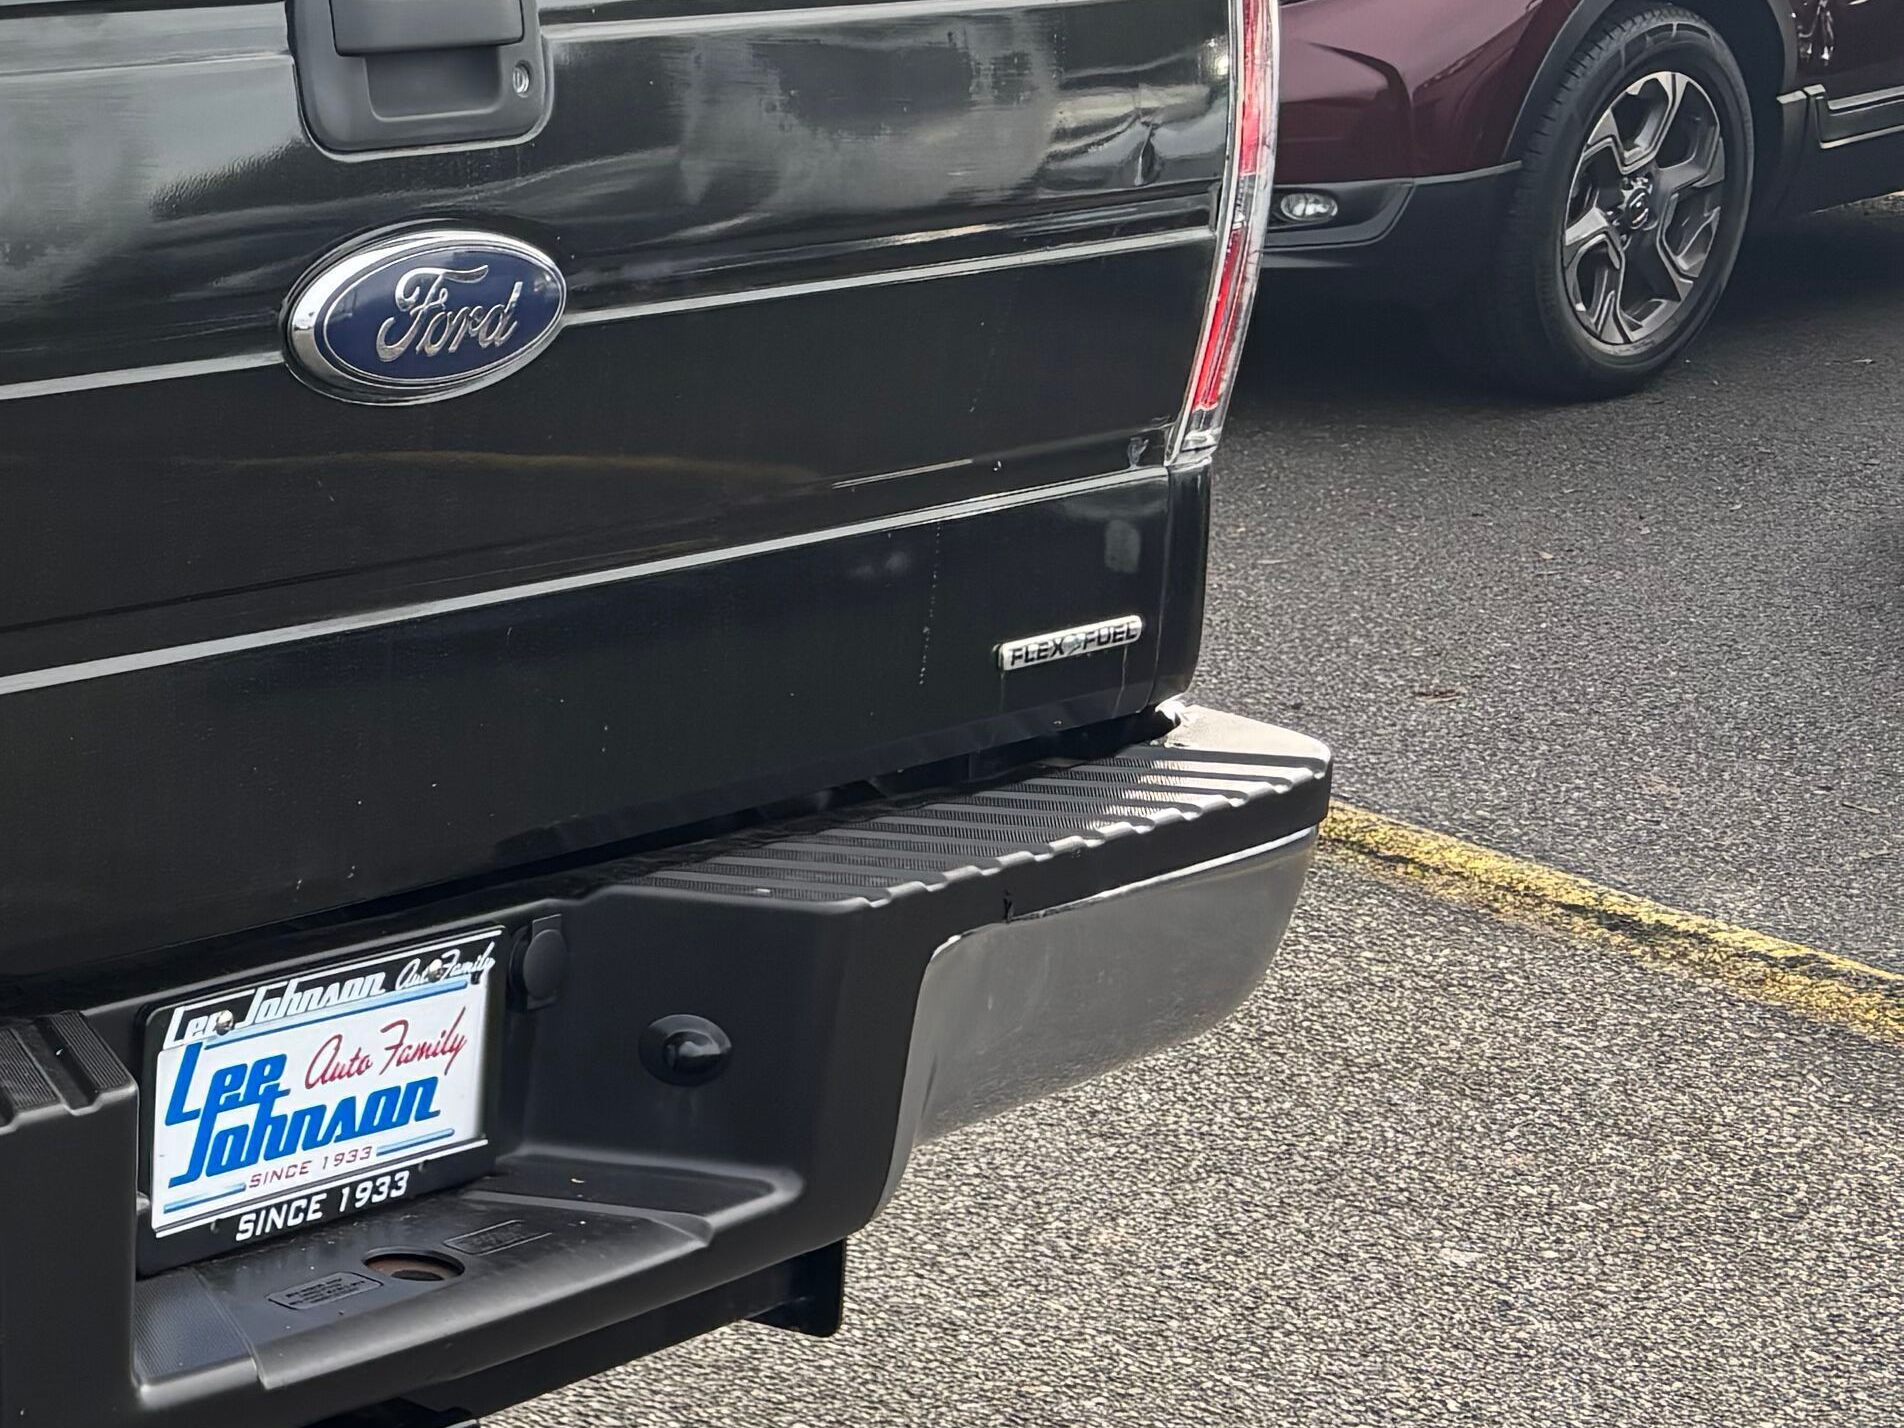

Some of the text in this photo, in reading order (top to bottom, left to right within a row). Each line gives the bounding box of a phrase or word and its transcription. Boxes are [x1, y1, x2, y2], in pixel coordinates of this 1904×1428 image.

[376, 264, 523, 362] Ford
[1010, 622, 1138, 666] FLEX FUEL
[234, 971, 386, 1029] Johnson
[395, 958, 438, 990] Aut
[439, 941, 496, 984] Family
[165, 1007, 468, 1126] Lee Auto Family
[169, 1076, 441, 1189] Johnson
[248, 1146, 373, 1189] SINCE 1933
[235, 1170, 410, 1242] SINCE 1933
